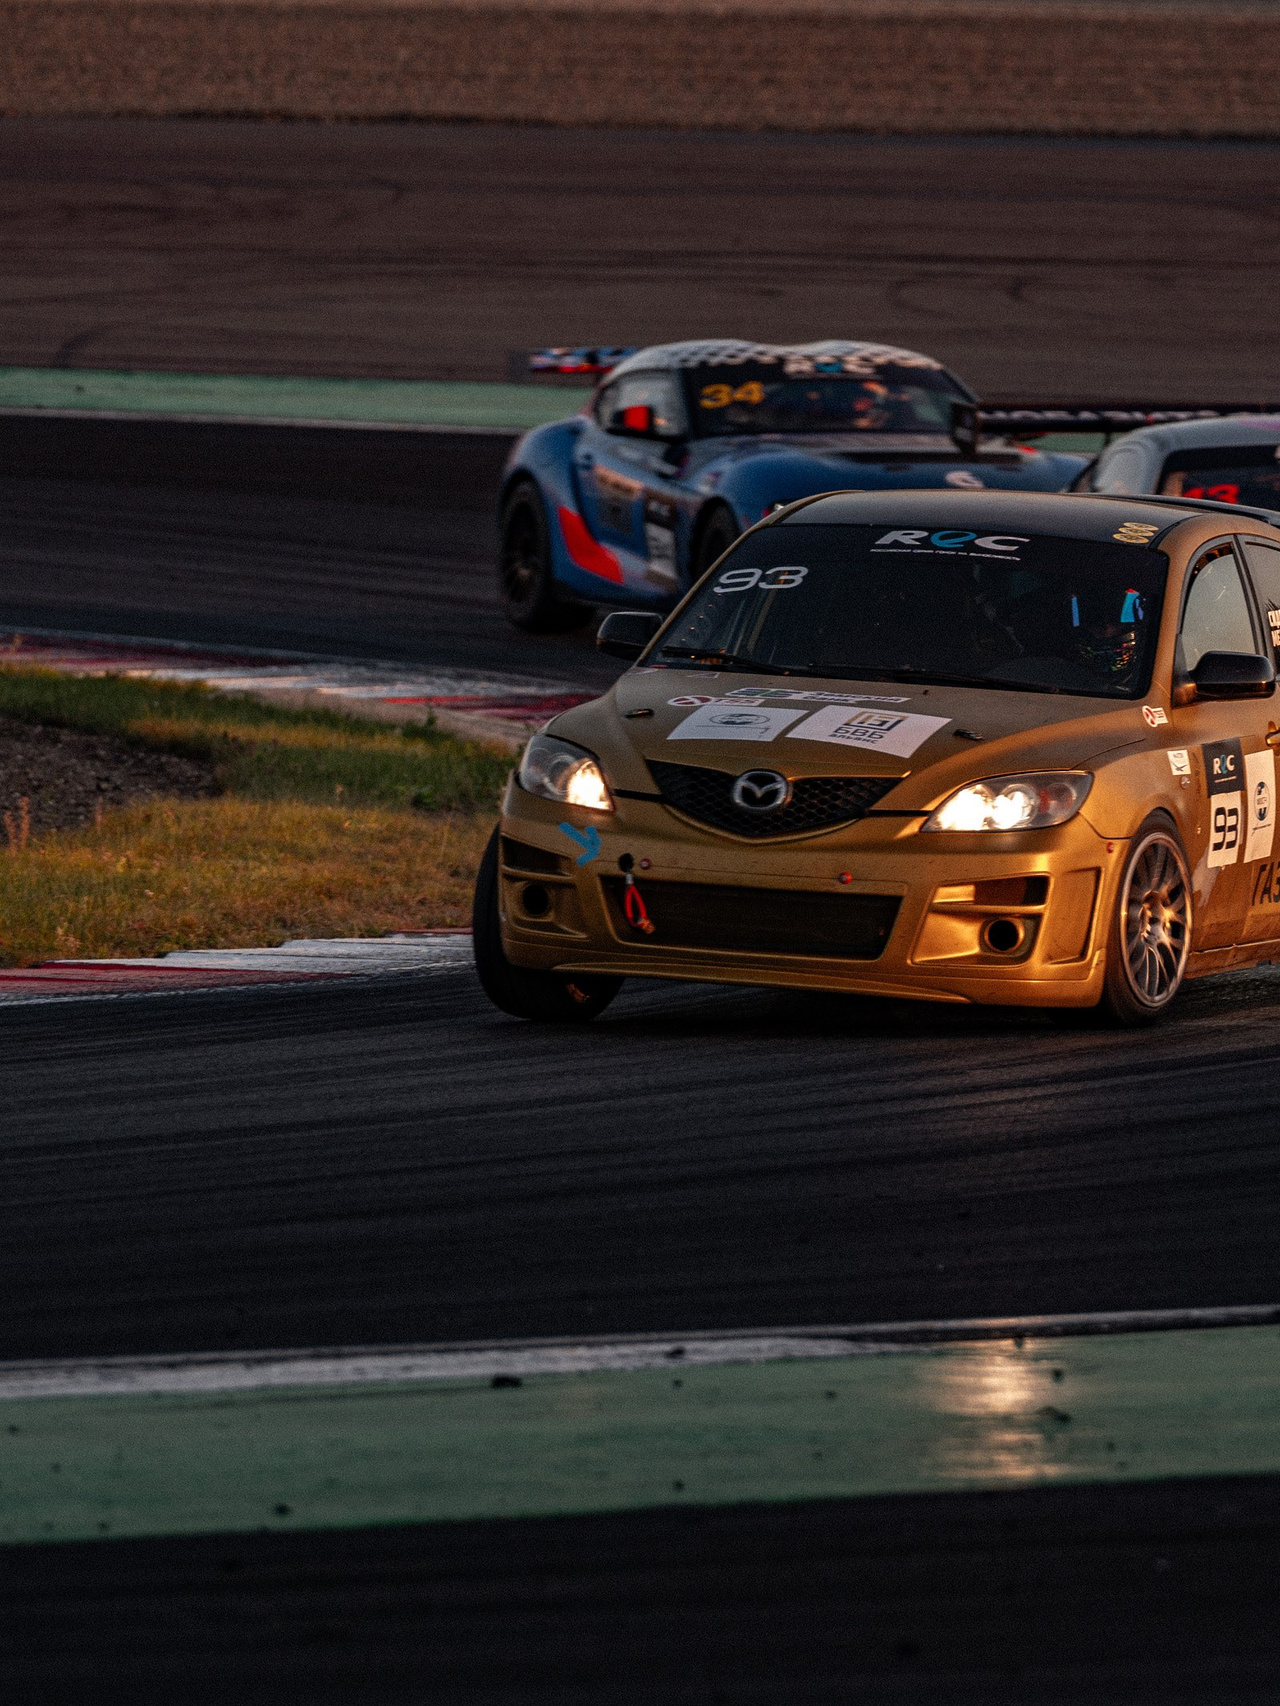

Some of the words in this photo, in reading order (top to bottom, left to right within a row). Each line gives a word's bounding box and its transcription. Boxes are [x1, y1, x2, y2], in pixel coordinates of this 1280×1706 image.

[699, 381, 765, 409] 34
[712, 566, 809, 593] 93
[833, 727, 886, 740] БВБ
[1212, 806, 1239, 852] 93
